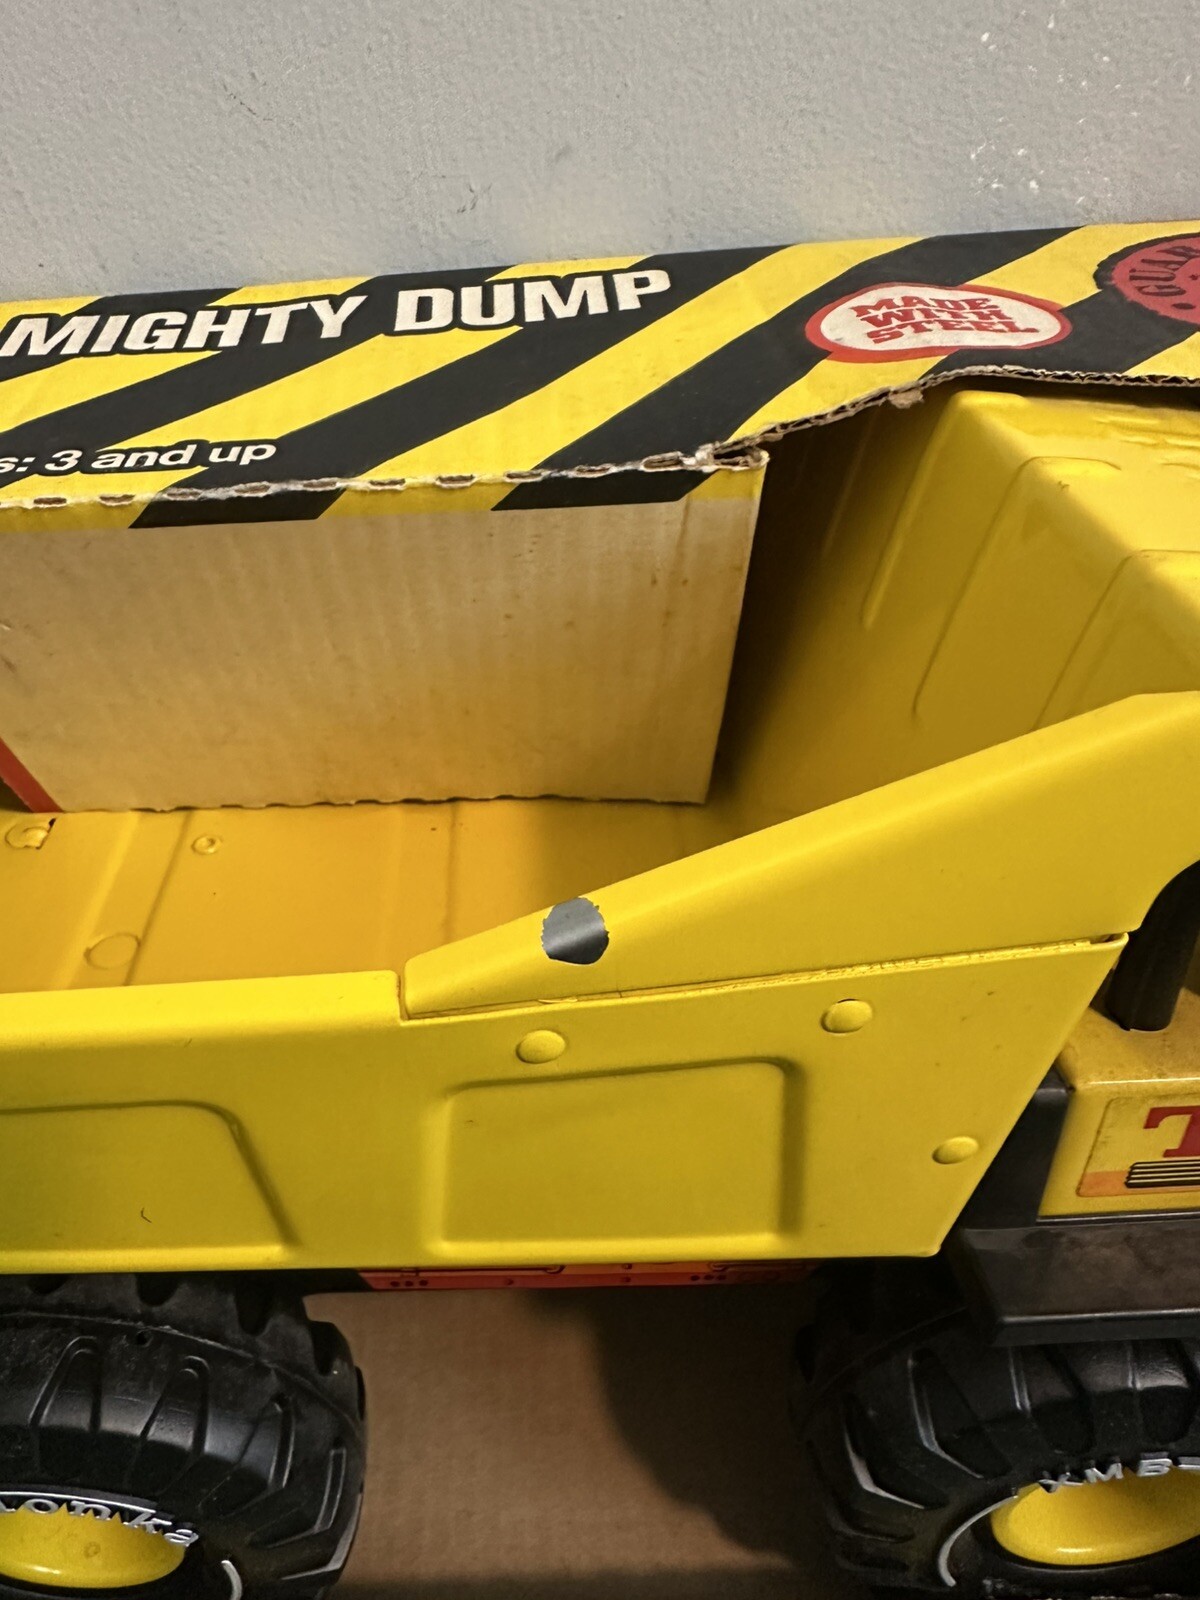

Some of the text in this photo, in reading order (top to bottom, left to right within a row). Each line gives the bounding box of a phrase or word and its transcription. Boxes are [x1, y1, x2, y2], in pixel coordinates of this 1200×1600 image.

[0, 269, 671, 357] MIGHTY DUMP
[849, 295, 1001, 318] MADE
[860, 306, 1014, 328] WITH
[866, 319, 1041, 344] STEEL
[44, 449, 83, 471] 3
[91, 444, 197, 469] and
[208, 443, 277, 466] up
